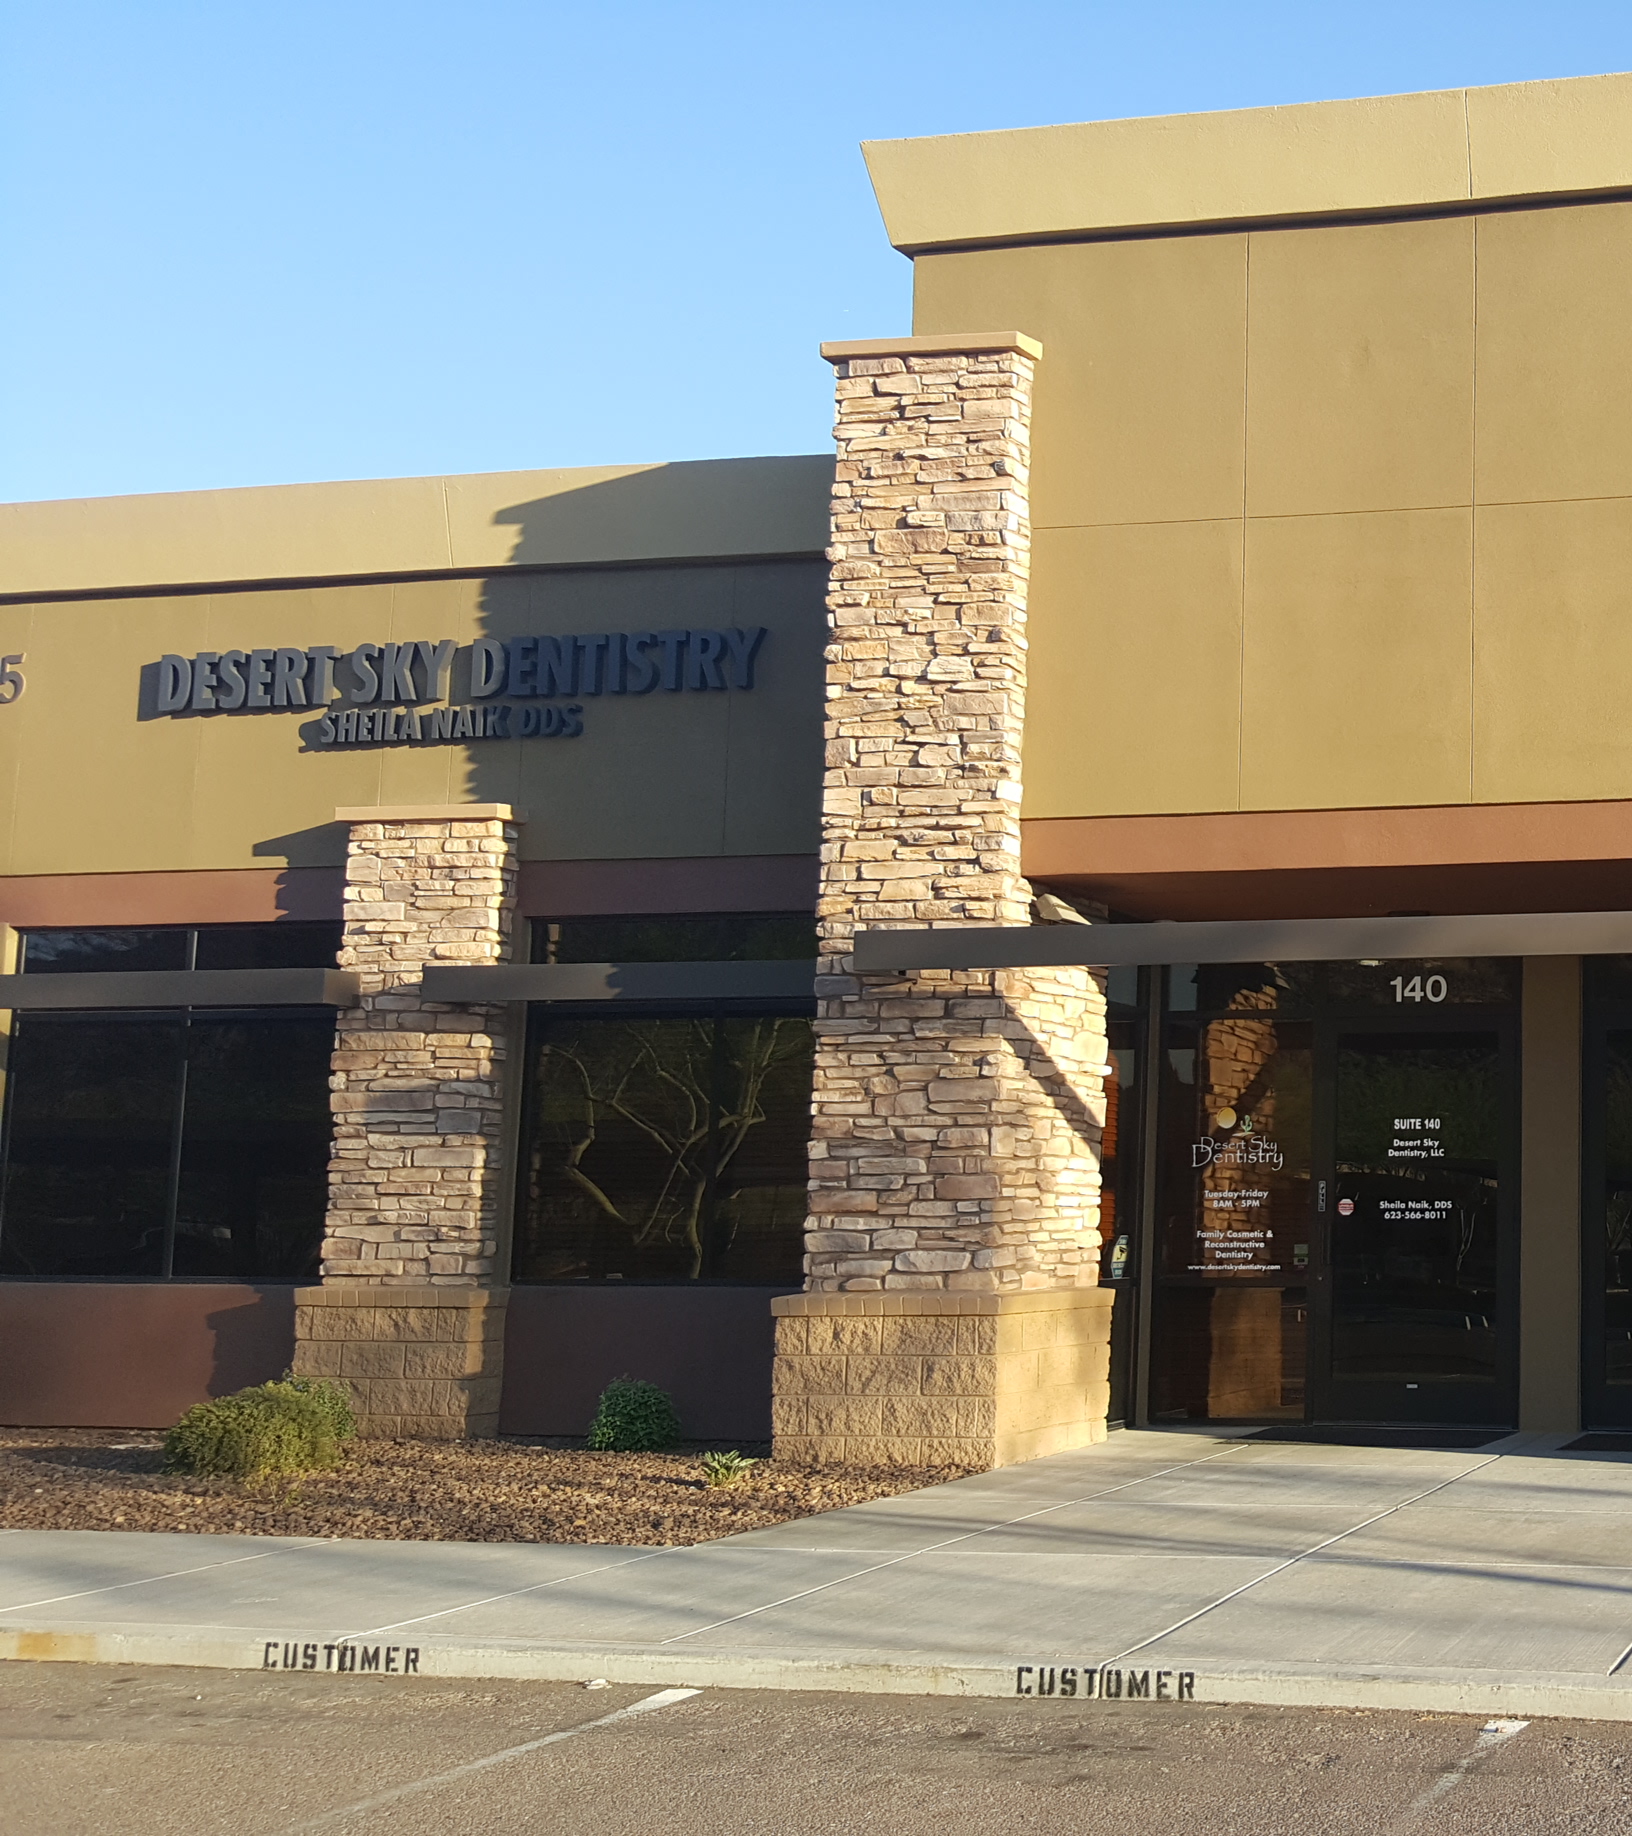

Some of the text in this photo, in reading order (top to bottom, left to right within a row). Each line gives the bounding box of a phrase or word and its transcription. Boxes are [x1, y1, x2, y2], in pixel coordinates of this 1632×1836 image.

[156, 626, 768, 712] DESERT SKY DENTISTRY
[0, 652, 26, 704] 5
[320, 702, 584, 743] SHEILA NAIK DDS
[1390, 975, 1448, 1002] 140
[1394, 1118, 1441, 1130] SUITE 140
[1201, 1135, 1278, 1155] Desert Sky
[1393, 1138, 1440, 1148] Desert Sky
[1191, 1144, 1284, 1171] Dentistry
[1388, 1149, 1445, 1158] Dentistry, LLC
[1204, 1189, 1269, 1199] Tuesday-Friday
[1212, 1200, 1233, 1208] 8AM
[1241, 1200, 1260, 1208] 5PM
[1379, 1201, 1453, 1209] Sheila Naik, DDS
[1384, 1211, 1447, 1220] 623-566-8011
[1196, 1230, 1274, 1239] Family Cosmetic &
[1204, 1240, 1265, 1248] Reconstructive
[1215, 1250, 1254, 1260] Dentistry
[1187, 1263, 1281, 1271] www.desertskydentistry.com
[262, 1641, 420, 1674] CUSTOMER
[1016, 1665, 1195, 1700] CUSTOMER
